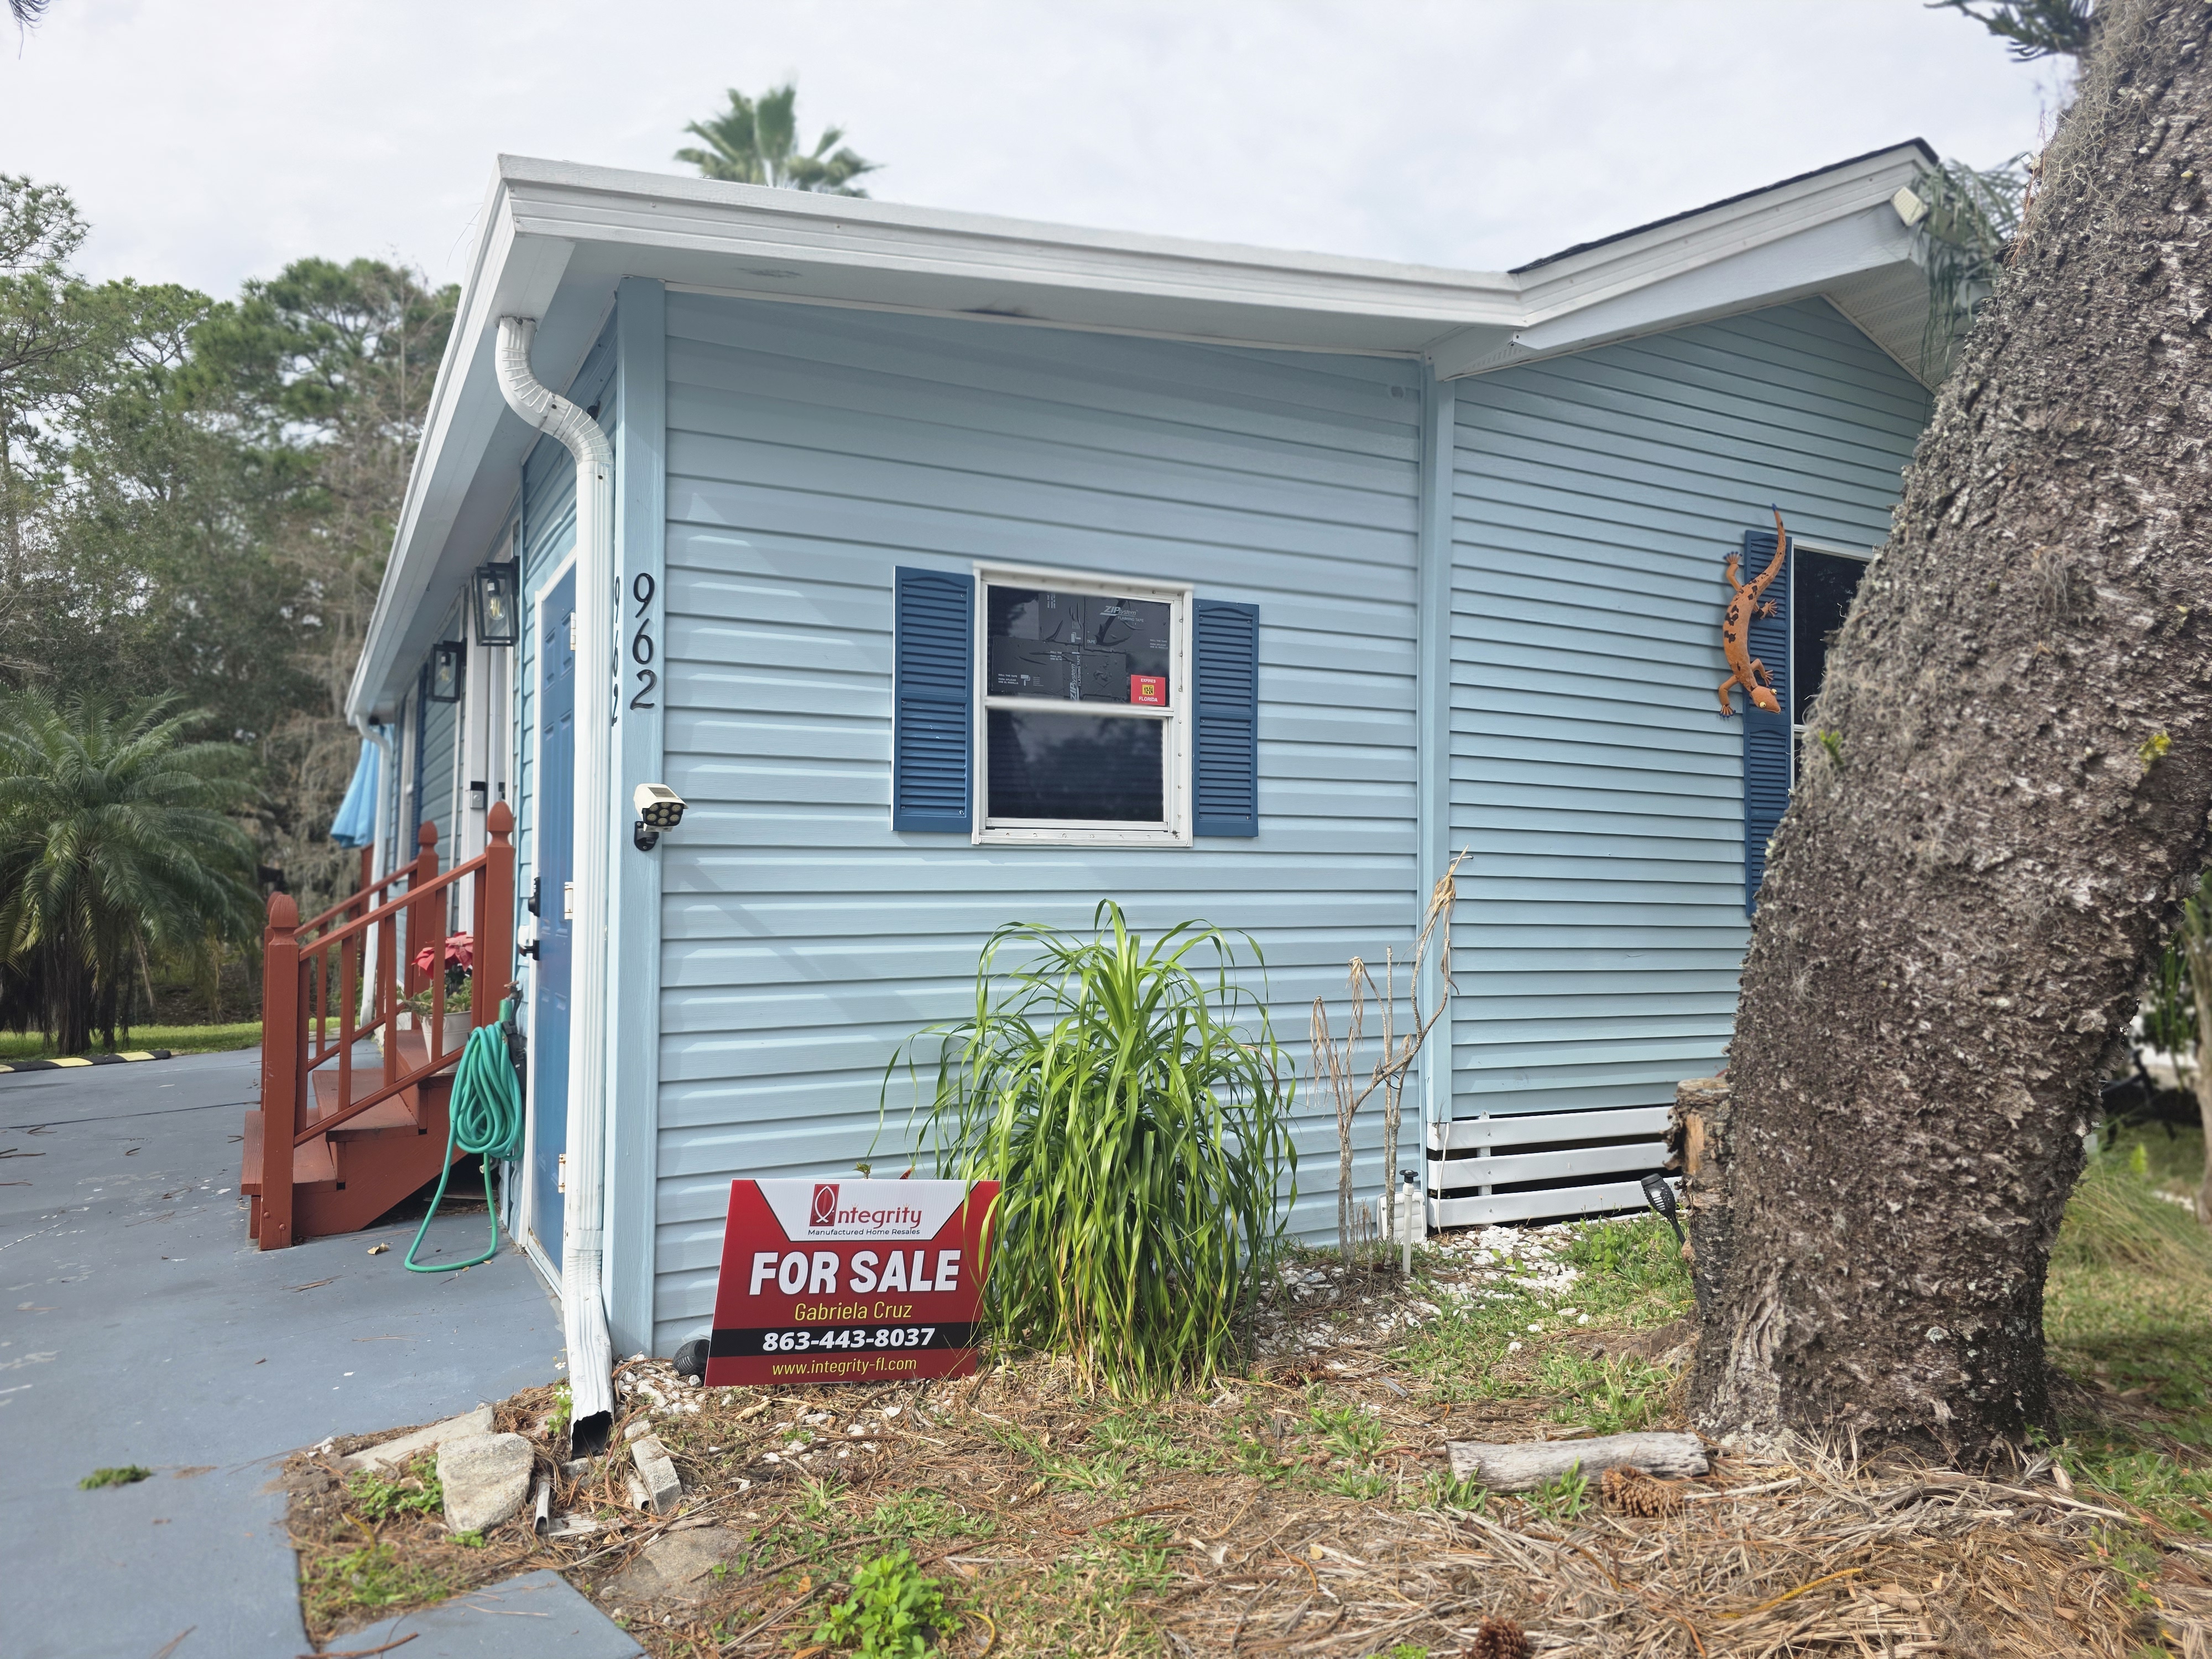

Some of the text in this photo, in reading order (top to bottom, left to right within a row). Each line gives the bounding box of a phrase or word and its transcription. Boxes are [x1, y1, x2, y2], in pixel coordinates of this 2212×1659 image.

[629, 572, 657, 710] 962
[1144, 686, 1153, 695] 12-24
[749, 1250, 961, 1295] FOR SALE
[795, 1301, 912, 1321] Gabriela Cruz
[763, 1328, 935, 1350] 863-443-8037
[772, 1357, 917, 1376] www.integrity-fl.com
